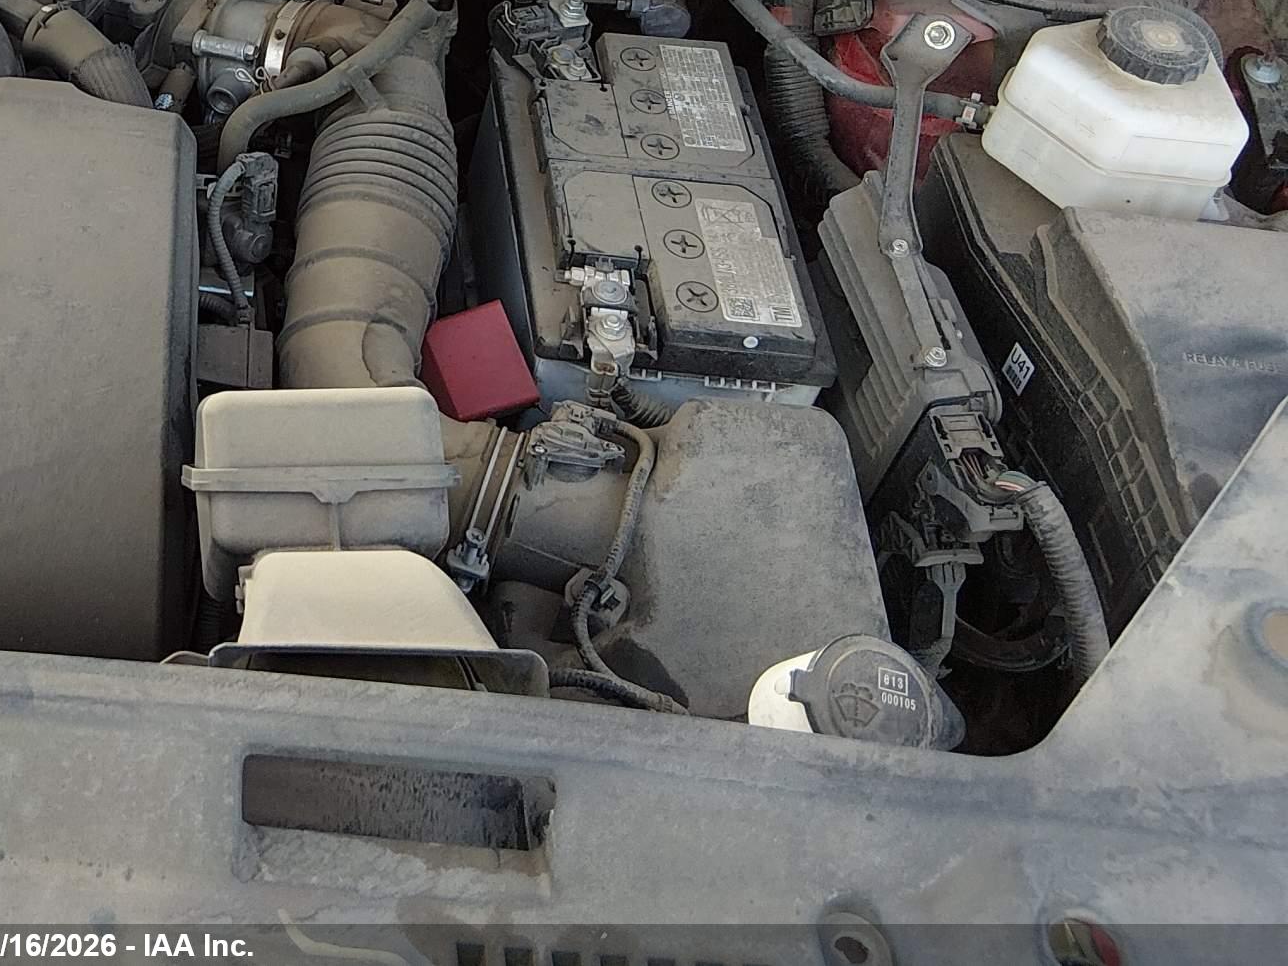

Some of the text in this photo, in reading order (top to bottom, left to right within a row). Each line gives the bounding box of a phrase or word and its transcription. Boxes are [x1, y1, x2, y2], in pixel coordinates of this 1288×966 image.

[1011, 347, 1030, 379] U41
[1182, 352, 1228, 368] RELAY
[881, 692, 916, 711] 000105
